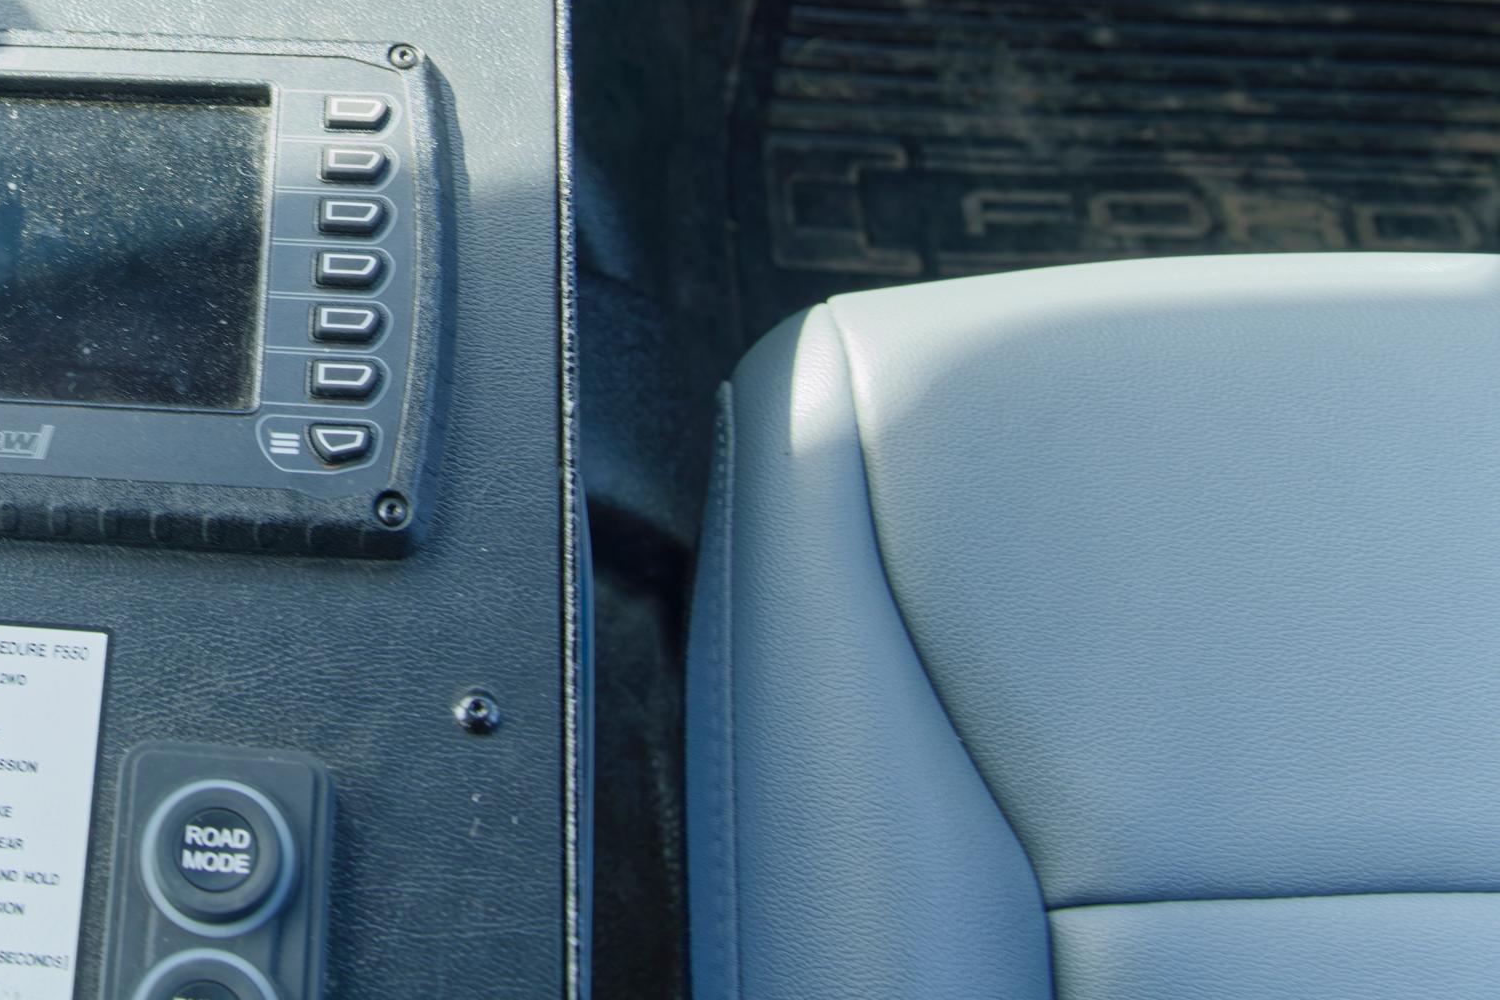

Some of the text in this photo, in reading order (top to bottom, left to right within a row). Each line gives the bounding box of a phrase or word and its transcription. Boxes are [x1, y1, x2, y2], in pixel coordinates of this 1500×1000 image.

[962, 189, 1480, 248] FORD
[52, 643, 90, 662] F550
[0, 672, 27, 687] 2WD
[184, 825, 251, 849] ROAD
[182, 849, 251, 874] MODE
[23, 869, 61, 886] HOLD
